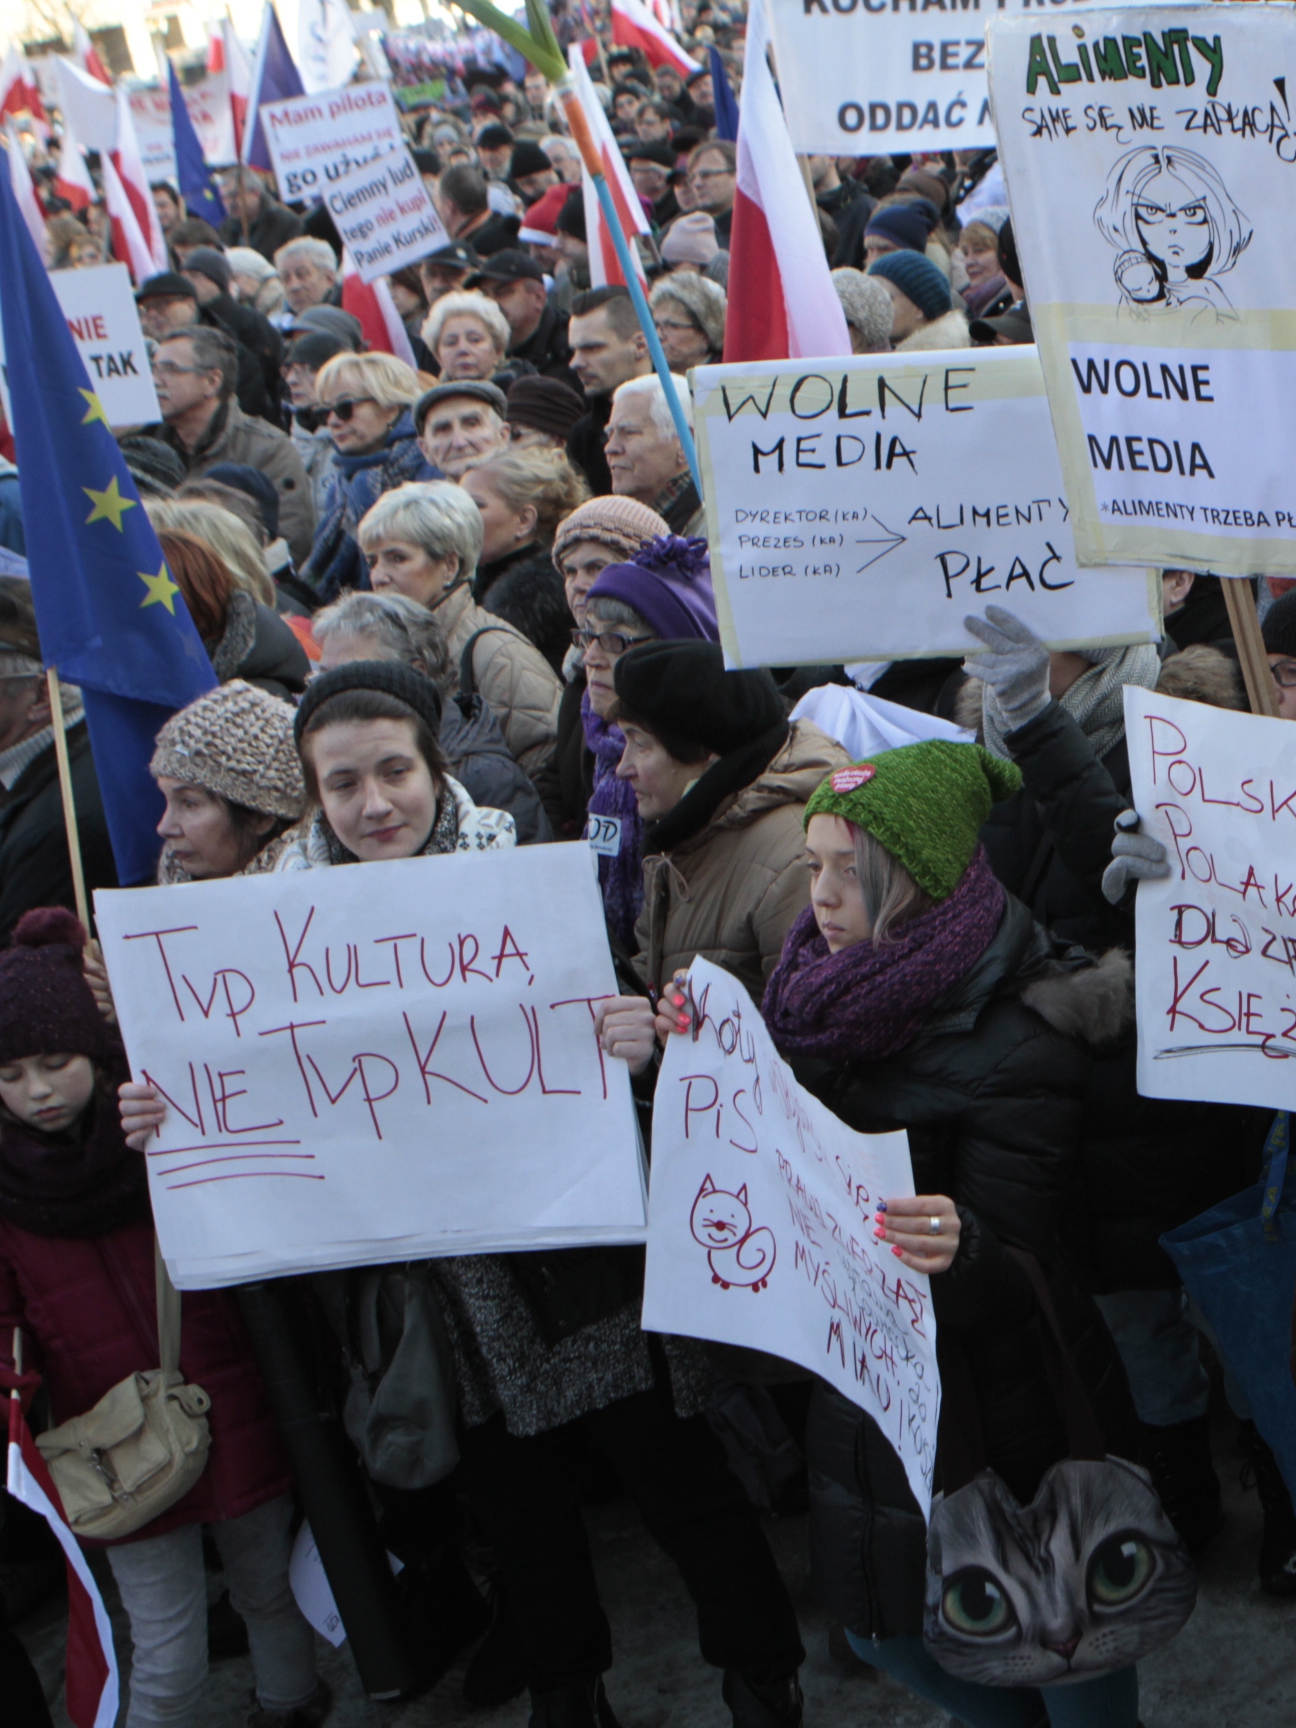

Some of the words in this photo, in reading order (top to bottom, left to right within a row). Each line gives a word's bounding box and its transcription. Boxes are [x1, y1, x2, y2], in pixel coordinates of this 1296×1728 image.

[912, 40, 985, 72] BEZ
[269, 105, 324, 130] Mam
[328, 89, 388, 120] pilota
[838, 90, 967, 133] ODDAĆ
[1022, 105, 1077, 141] SAME
[1083, 102, 1132, 144] SIĘ
[1128, 103, 1164, 131] NIE
[285, 167, 318, 195] go
[330, 173, 391, 216] Ciemny
[386, 156, 415, 187] lud
[343, 218, 374, 244] tego
[375, 207, 398, 228] nie
[397, 190, 429, 219] kupi
[353, 238, 392, 269] Panie
[392, 215, 442, 247] Kurski!
[66, 314, 109, 341] NIE
[90, 350, 139, 378] TAK
[1070, 358, 1214, 402] WOLNE
[721, 367, 976, 422] WOLNE
[751, 431, 918, 475] MEDIA
[1087, 434, 1216, 479] MEDIA
[908, 497, 1070, 529] ALIMENTY
[1200, 507, 1271, 528] TRZEBA
[738, 535, 805, 549] PREZES
[739, 564, 797, 579] LIDER
[935, 541, 1075, 598] PŁAĆ
[589, 818, 618, 842] OD
[141, 1061, 284, 1138] NIE
